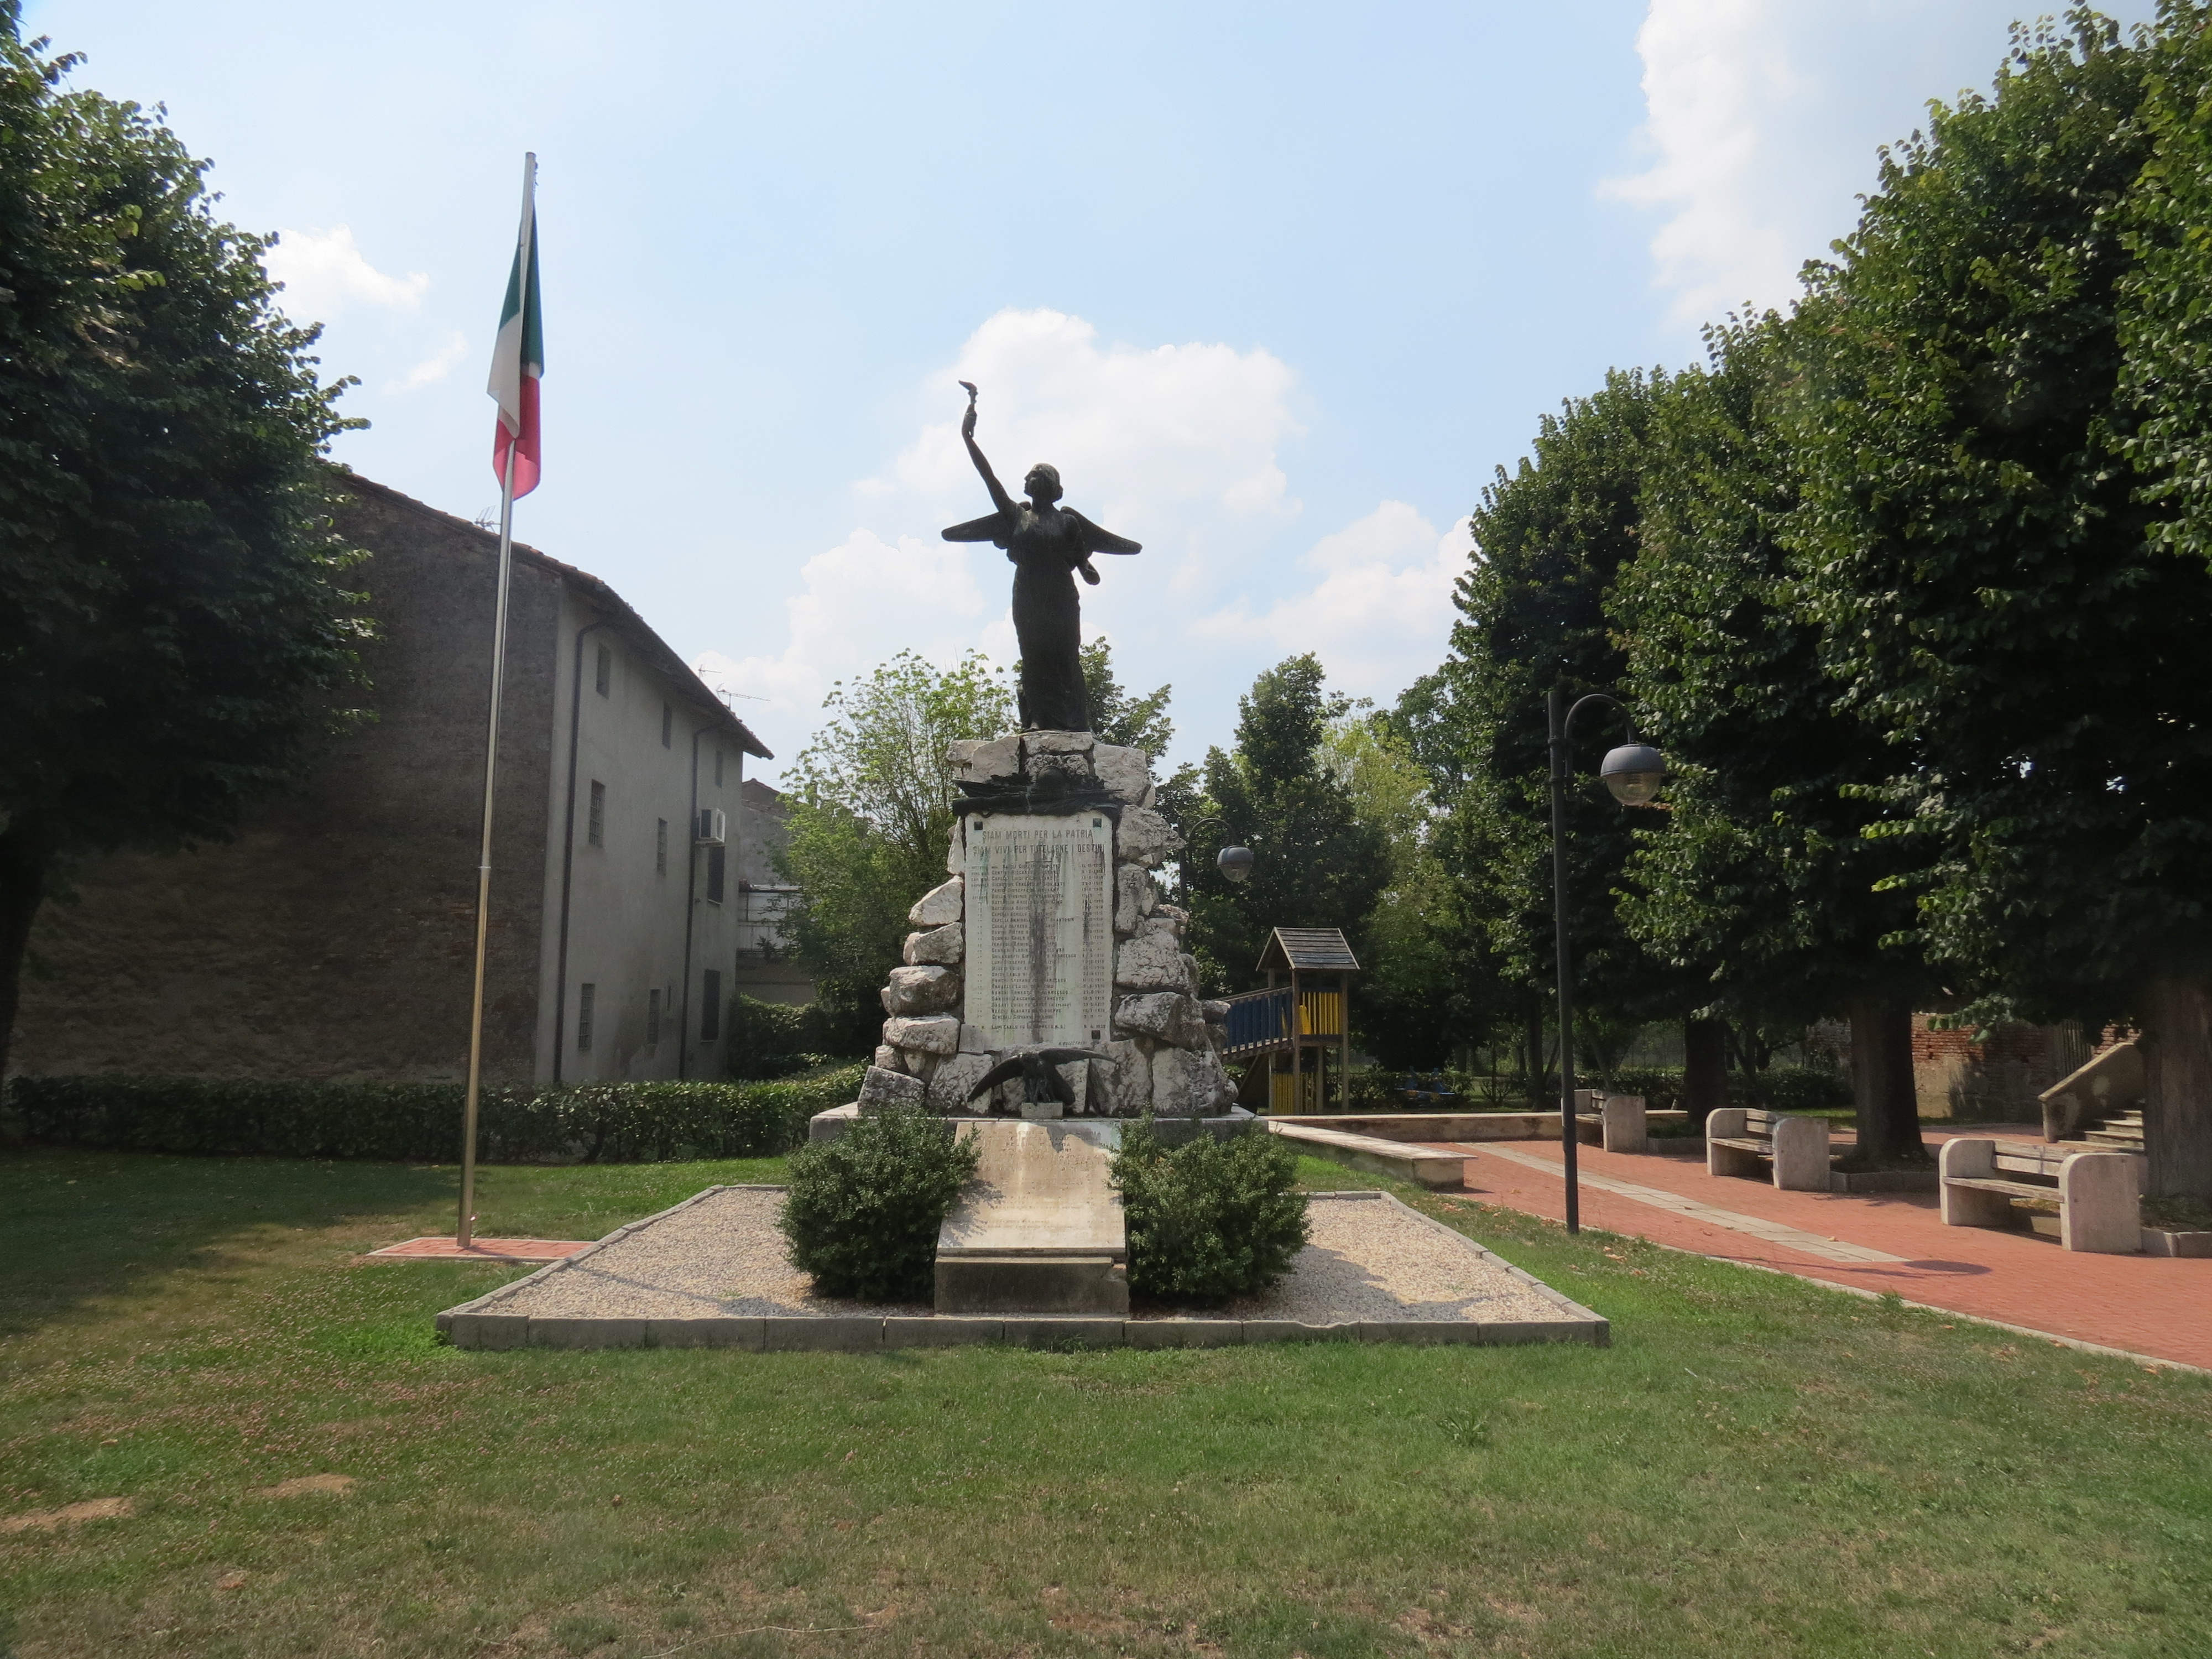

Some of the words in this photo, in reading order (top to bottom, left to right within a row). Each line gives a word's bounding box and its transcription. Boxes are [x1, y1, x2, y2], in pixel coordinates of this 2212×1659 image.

[982, 831, 1001, 839] SIAM
[1006, 831, 1030, 839] MORTI
[1035, 830, 1048, 839] PER
[1052, 830, 1062, 838] LA
[1066, 830, 1093, 838] PATRIA
[973, 846, 991, 854] SIAM
[995, 846, 1010, 854] VIVI
[1014, 845, 1027, 853] PER
[1030, 844, 1068, 853] TUTELARNE
[1077, 844, 1105, 852] DESTINI
